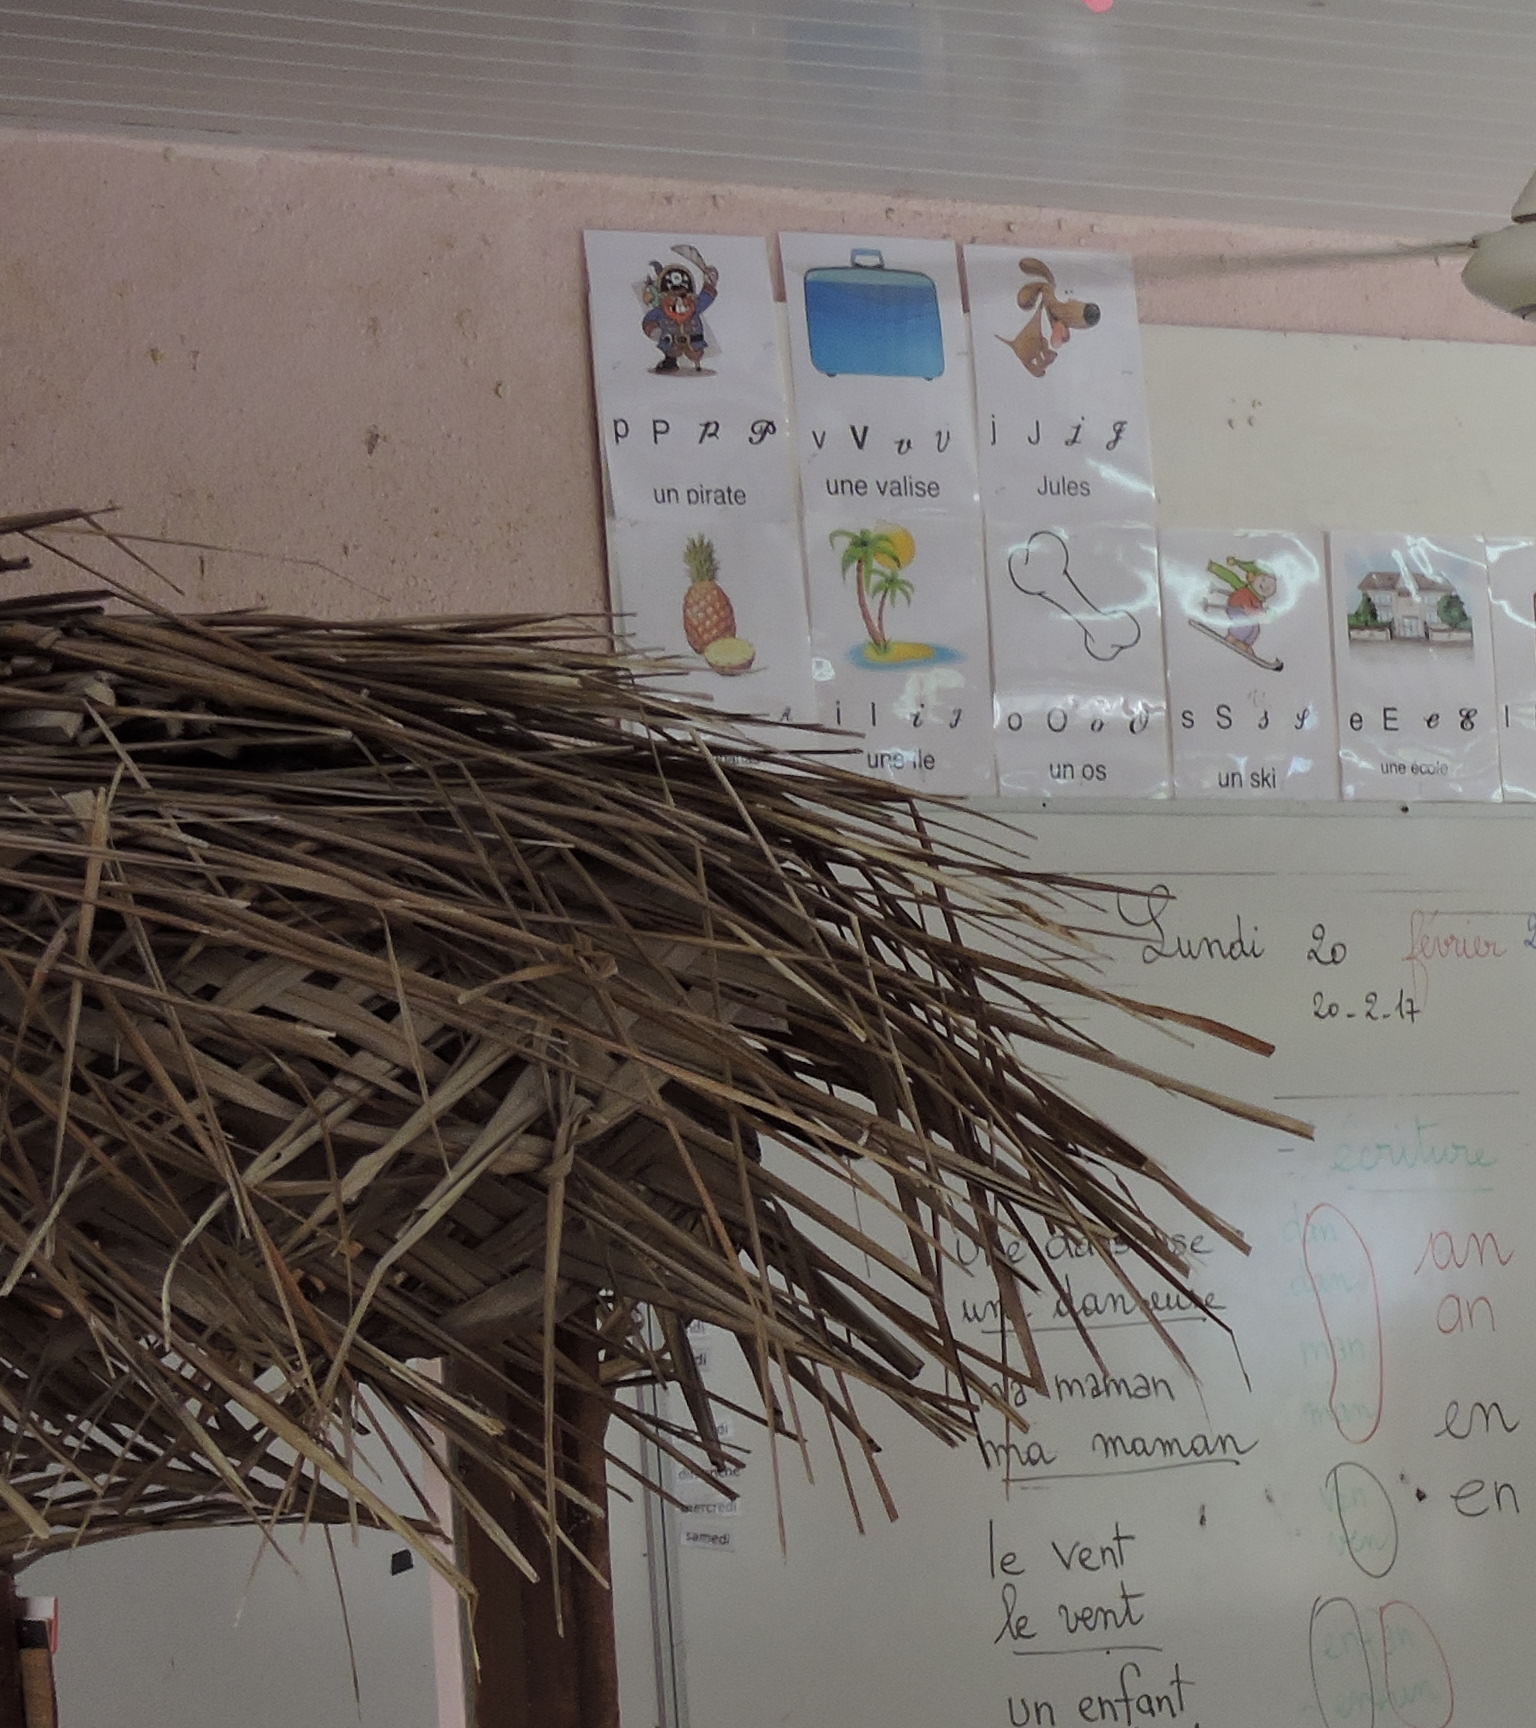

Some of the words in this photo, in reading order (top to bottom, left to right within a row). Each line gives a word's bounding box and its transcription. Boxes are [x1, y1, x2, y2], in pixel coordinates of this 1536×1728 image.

[613, 418, 629, 447] p
[652, 419, 669, 444] P
[811, 430, 827, 450] v
[850, 425, 869, 450] V
[1027, 419, 1042, 446] J
[653, 486, 681, 506] un
[687, 482, 747, 508] pirate
[826, 478, 870, 498] une
[877, 474, 940, 498] valise
[1036, 474, 1091, 498] Jules
[1008, 712, 1023, 732] o
[1048, 708, 1068, 733] O
[1181, 709, 1195, 729] s
[1216, 705, 1233, 730] S
[1350, 711, 1363, 731] e
[1384, 708, 1398, 732] E
[1049, 764, 1077, 785] un
[1082, 762, 1107, 782] os
[1218, 769, 1243, 790] un
[1249, 764, 1278, 790] ski
[1381, 761, 1406, 776] une
[1117, 884, 1265, 964] Lundi
[1306, 923, 1347, 965] 20
[1403, 909, 1508, 1020] février
[1414, 1229, 1516, 1275] an
[1436, 1291, 1497, 1335] an
[1056, 1373, 1176, 1402] maman
[1433, 1399, 1521, 1440] en
[980, 1436, 1058, 1468] ma
[1091, 1429, 1260, 1460] maman
[1449, 1477, 1521, 1516] en
[686, 1531, 730, 1546] samedi
[988, 1519, 1026, 1576] le
[1052, 1522, 1136, 1572] vent
[994, 1583, 1037, 1646] le
[1059, 1580, 1146, 1629] vent
[1008, 1694, 1057, 1728] un
[1079, 1662, 1197, 1726] enfant
